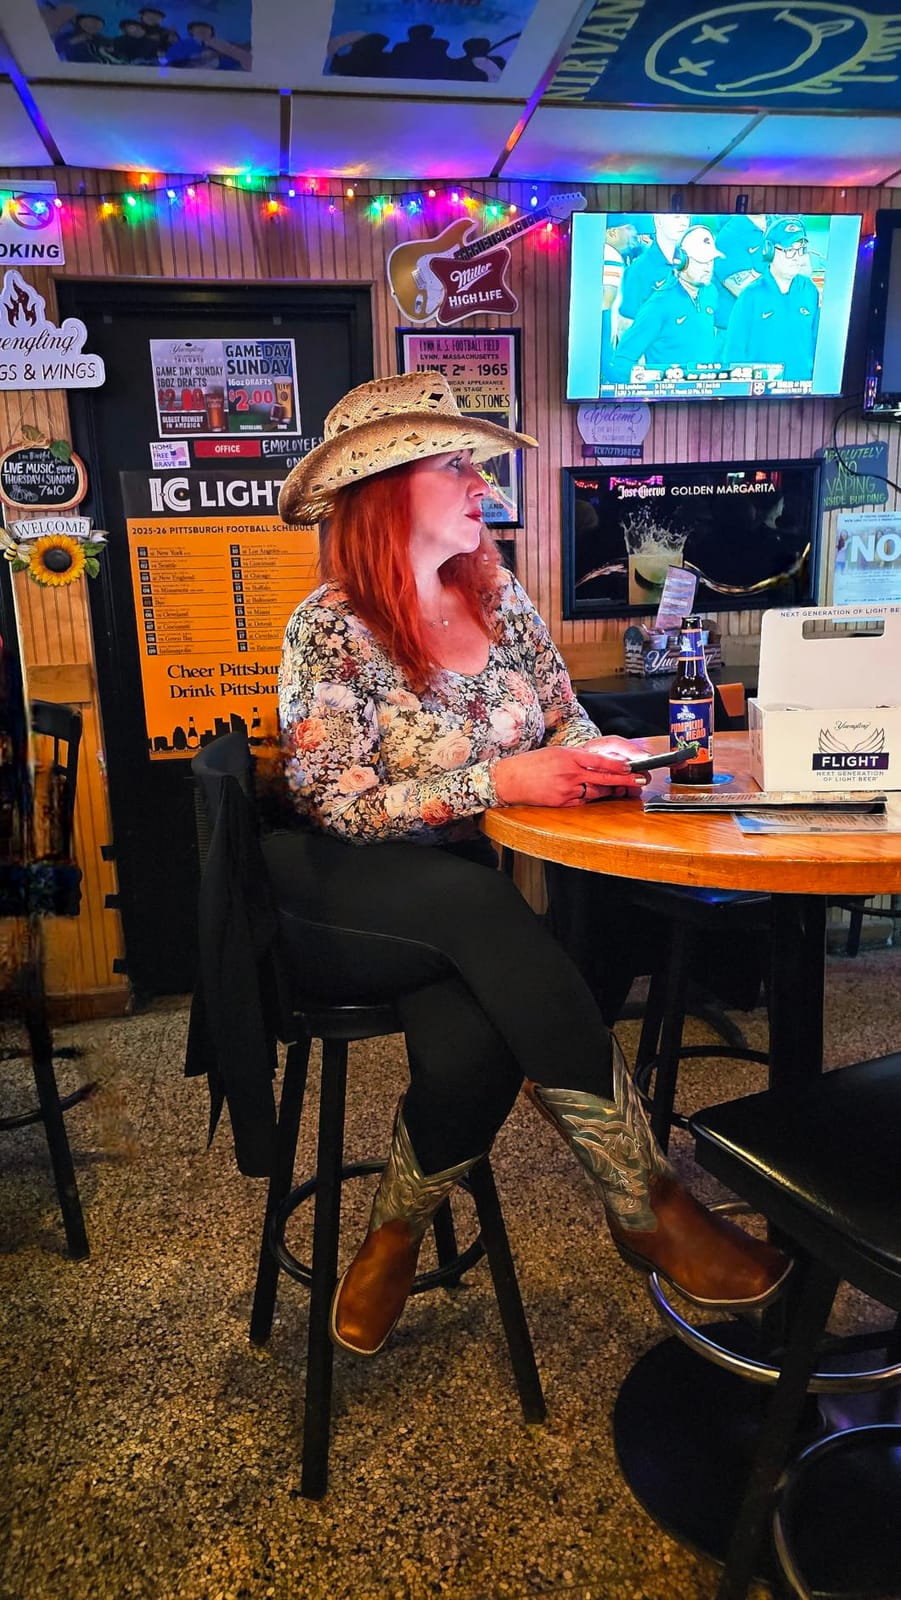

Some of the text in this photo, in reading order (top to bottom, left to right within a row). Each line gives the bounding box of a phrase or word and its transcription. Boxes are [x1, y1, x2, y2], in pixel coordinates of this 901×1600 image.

[450, 263, 492, 293] Miller
[448, 289, 503, 307] HIGH LIFE
[225, 345, 289, 358] GAME DAY
[452, 339, 481, 352] FOOTBALL
[484, 339, 500, 351] FIELD
[24, 364, 36, 381] &
[42, 362, 96, 381] WINGS
[156, 366, 223, 376] GAME DAY SUNDAY
[227, 359, 289, 375] SUNDAY
[477, 363, 508, 376] 1965
[177, 377, 207, 387] DRAFTS
[245, 378, 272, 386] DRAFTS
[229, 389, 273, 411] $2.00
[475, 393, 510, 409] STONES
[583, 405, 643, 425] Welcome
[214, 445, 241, 454] OFFICE
[4, 462, 24, 474] LIVE
[26, 463, 55, 474] MUSIC
[838, 460, 858, 478] NO
[2, 474, 41, 485] THURSDAY
[45, 474, 76, 485] SUNDAY
[826, 475, 876, 496] VAPING
[617, 483, 776, 499] Jose Cuervo GOLDEN MARGARITA
[849, 492, 886, 505] BUILDING
[15, 521, 87, 537] WELCOME
[132, 524, 315, 535] 2025-26 PITTSBURGH FOOTBALL SCHEDULE
[802, 609, 850, 617] GENERATION
[167, 662, 280, 679] Cheer Pittsbur
[170, 682, 279, 699] Drink Pittsbur
[670, 718, 704, 733] PUMPKIN
[686, 728, 706, 741] HEAD
[822, 755, 879, 768] FLIGHT
